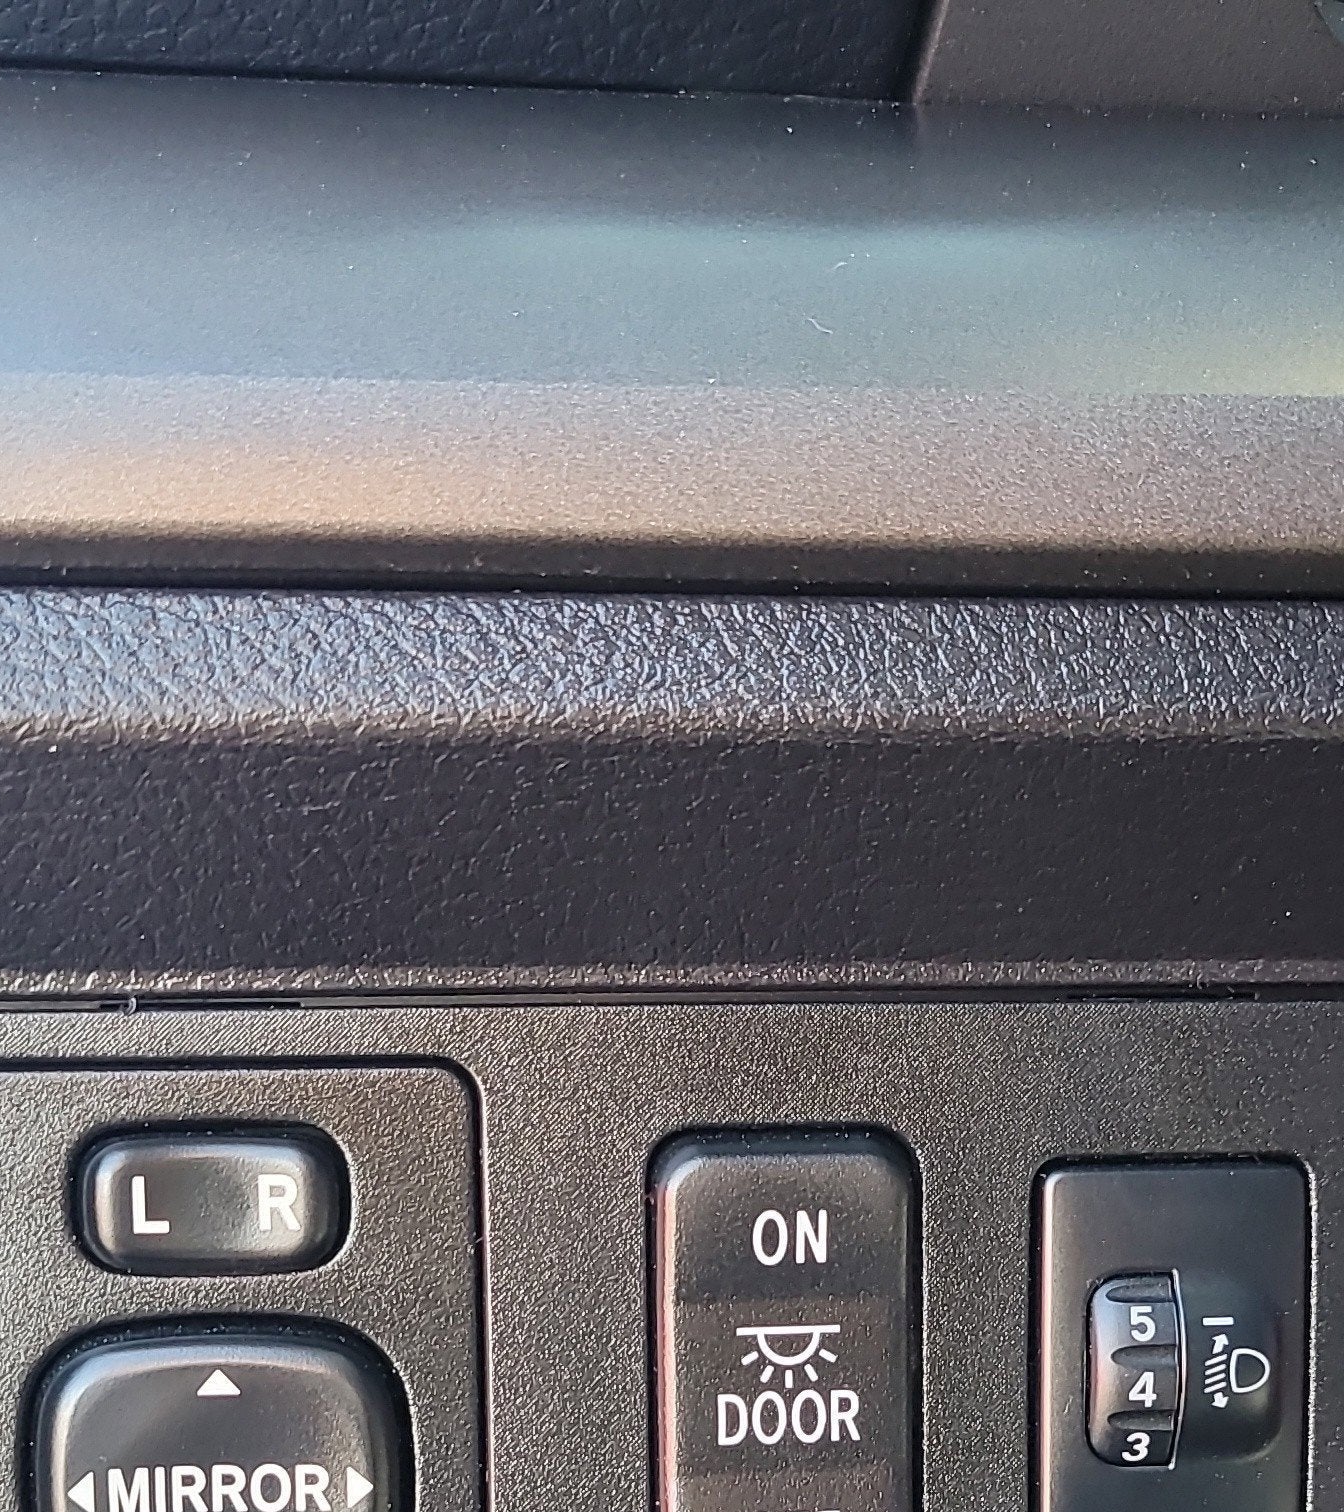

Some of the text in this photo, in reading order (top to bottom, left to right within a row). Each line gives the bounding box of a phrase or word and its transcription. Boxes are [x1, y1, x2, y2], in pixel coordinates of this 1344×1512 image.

[131, 1175, 170, 1235] L
[257, 1174, 301, 1232] R
[752, 1209, 828, 1265] ON
[1129, 1305, 1155, 1342] 5
[716, 1389, 861, 1446] DOOR
[1128, 1371, 1157, 1408] 4
[1122, 1432, 1149, 1461] 3
